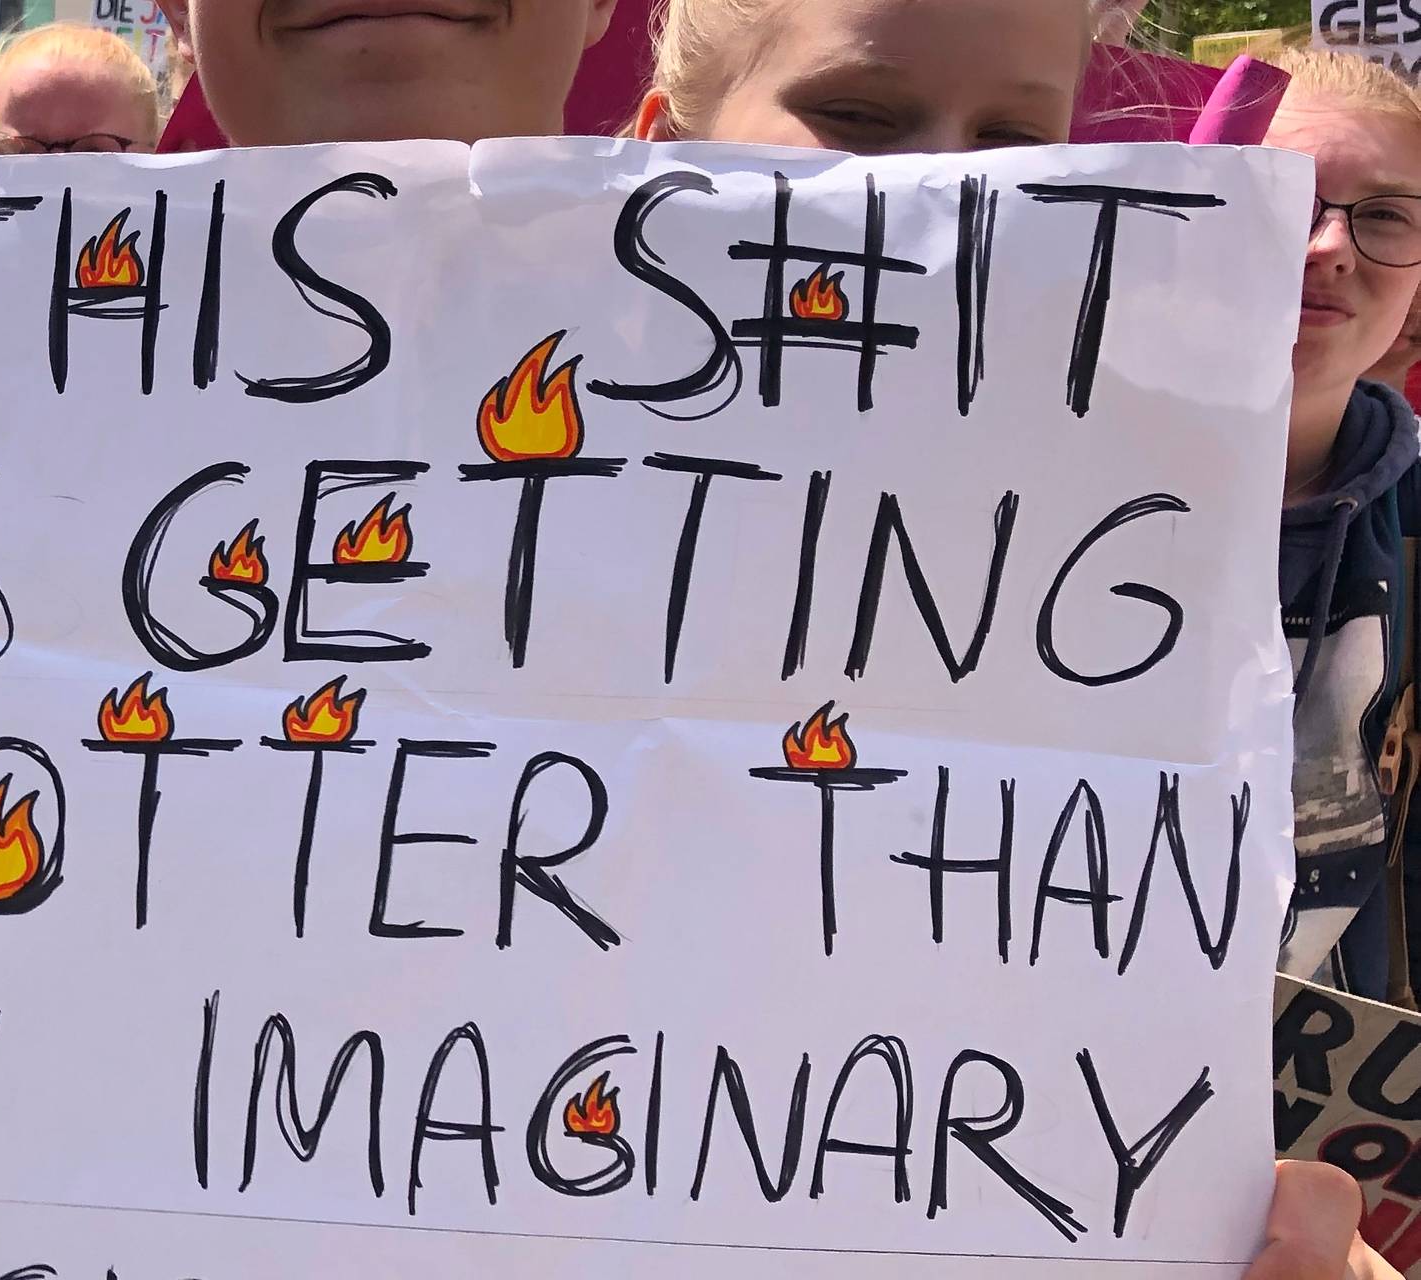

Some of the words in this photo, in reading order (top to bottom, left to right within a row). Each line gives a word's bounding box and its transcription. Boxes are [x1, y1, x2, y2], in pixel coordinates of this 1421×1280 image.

[122, 452, 1192, 688] GETTING
[748, 764, 1252, 976] THAN
[194, 990, 1216, 1243] IMAGINARY
